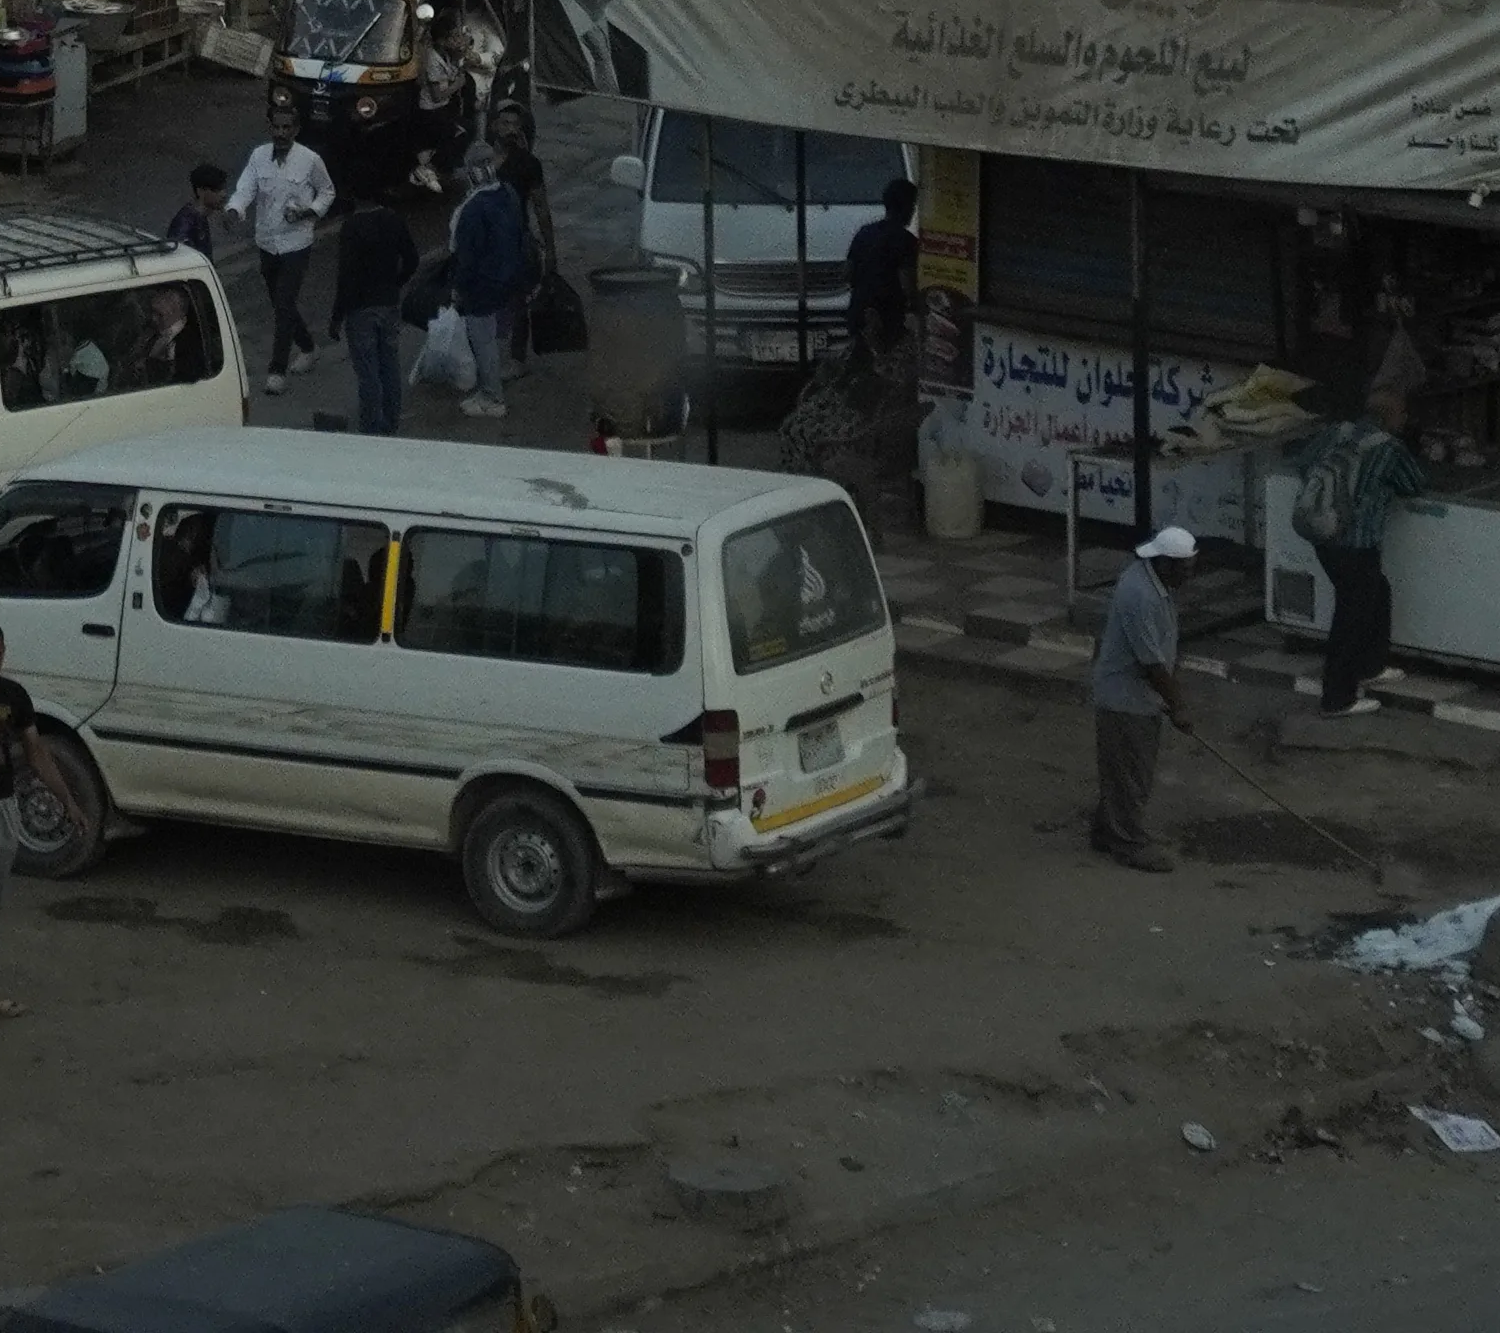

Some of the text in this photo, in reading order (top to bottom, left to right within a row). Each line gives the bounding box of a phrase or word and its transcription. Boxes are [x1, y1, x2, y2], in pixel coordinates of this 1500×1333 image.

[891, 8, 1252, 98] لبيع اللحوم والسلع الغذائية
[1102, 96, 1158, 141] وزارة
[1165, 105, 1237, 146] رعاية
[1245, 117, 1299, 147] تحت
[982, 335, 1070, 395] للتجارة
[1152, 357, 1214, 420] شركة
[983, 403, 1038, 441] الجزارة
